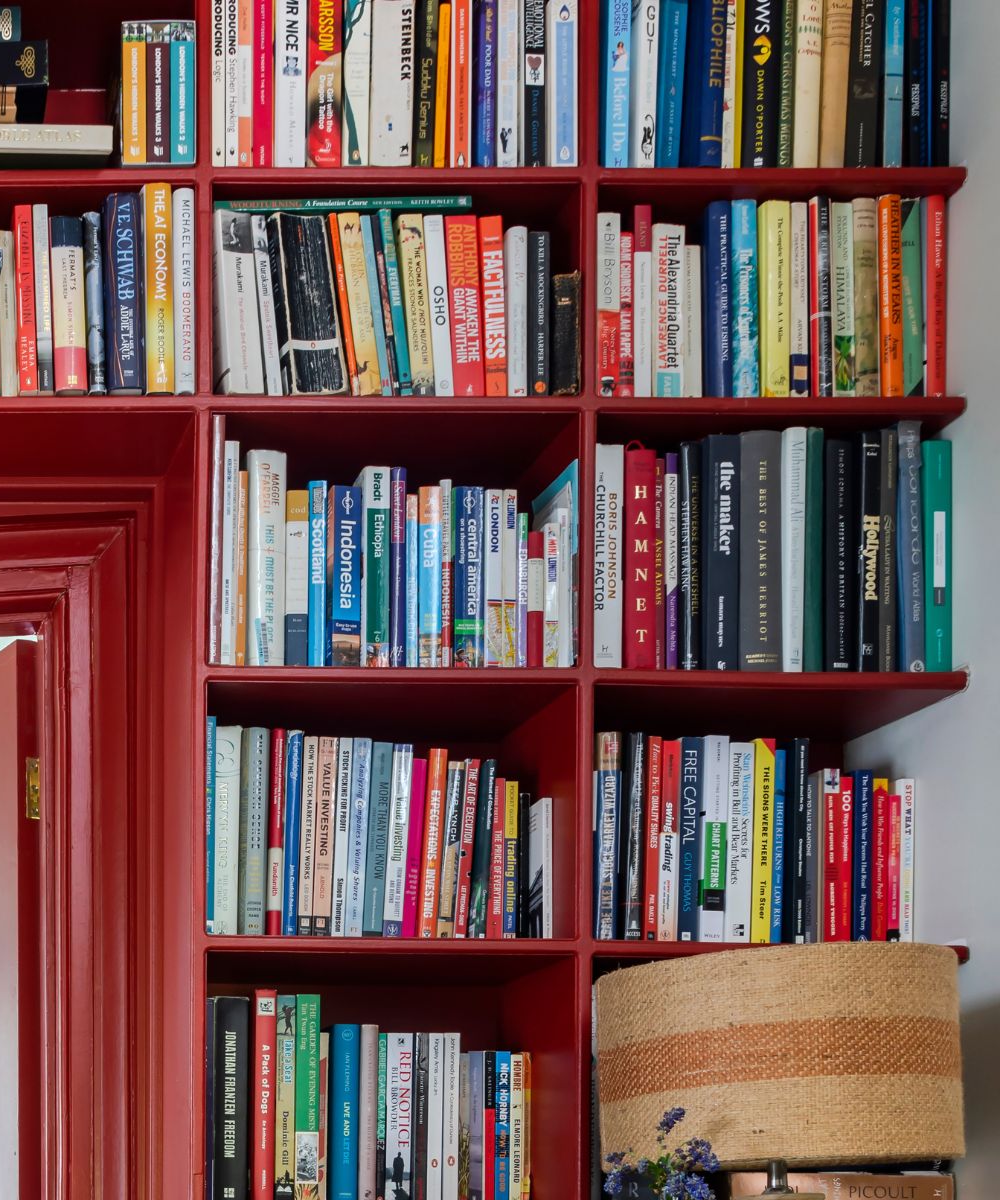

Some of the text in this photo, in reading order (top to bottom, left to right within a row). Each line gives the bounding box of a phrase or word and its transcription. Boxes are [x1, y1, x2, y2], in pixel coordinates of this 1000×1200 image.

[286, 20, 299, 52] NICE
[400, 8, 411, 81] STEINBECK
[621, 2, 631, 32] SOPHIE
[863, 14, 875, 67] CATCHER
[154, 47, 162, 136] LONDON'S HIDDEN WALKS
[420, 57, 432, 98] Sudoku
[613, 77, 627, 121] Before
[754, 69, 764, 153] DAWN O'PORTER
[780, 52, 793, 119] CHRISTMAS
[34, 131, 82, 143] ATLAS
[116, 228, 135, 300] SCHWAB
[154, 189, 168, 301] THE AI ECONOMY
[235, 256, 244, 293] Murakami
[260, 259, 270, 297] Murakami
[448, 223, 465, 287] ROBBINS
[463, 223, 479, 286] ANTHONY
[604, 231, 616, 304] Bill Bryson
[182, 199, 191, 362] MICHAEL LEWIS BOOMERANG
[433, 285, 446, 326] OSHO
[483, 250, 506, 360] FACTFULNESS
[658, 234, 668, 369] LAWRENCE DURRELL
[667, 235, 681, 368] The Alexandria Quartet
[836, 266, 847, 332] HIMALAYA
[453, 289, 467, 363] GIANT WITHIN
[464, 288, 480, 362] AWAKEN THE
[270, 473, 280, 507] MAGGIE
[290, 505, 306, 514] cod
[372, 471, 383, 502] Bradt
[506, 497, 516, 530] LONDON
[719, 460, 738, 555] the maker
[311, 517, 325, 585] Scotland
[373, 513, 385, 560] Ethiopia
[423, 528, 438, 569] Cuba
[490, 506, 500, 553] LONDON
[593, 484, 606, 611] CHURCHILL FACTOR
[607, 493, 618, 599] BORIS JOHNSON
[758, 460, 767, 643] THE BEST JAMES HERRIOT
[863, 514, 881, 601] Hollywood
[339, 519, 357, 609] Indonesia
[467, 518, 478, 616] central america
[519, 548, 528, 605] EDINBURGH
[634, 484, 649, 643] HAMNET
[441, 567, 450, 628] INDONESIA
[319, 762, 332, 857] VALUE INVESTING
[682, 749, 698, 845] FREE CAPITAL
[760, 766, 771, 867] THE SIGNS WERE THERE
[423, 789, 441, 919] EXPECTATIONS INVESTING
[505, 840, 517, 914] trading online
[223, 1030, 236, 1116] JONATHAN FRANZEN
[397, 1051, 412, 1148] RED NOTICE
[499, 1062, 511, 1127] NICK HORNBY
[513, 1060, 522, 1092] HOMBRE
[223, 1119, 236, 1159] FREEDOM
[390, 1088, 399, 1131] BROWDER
[512, 1119, 521, 1183] ELMORE LEONARD
[848, 1185, 918, 1199] PICOULT
